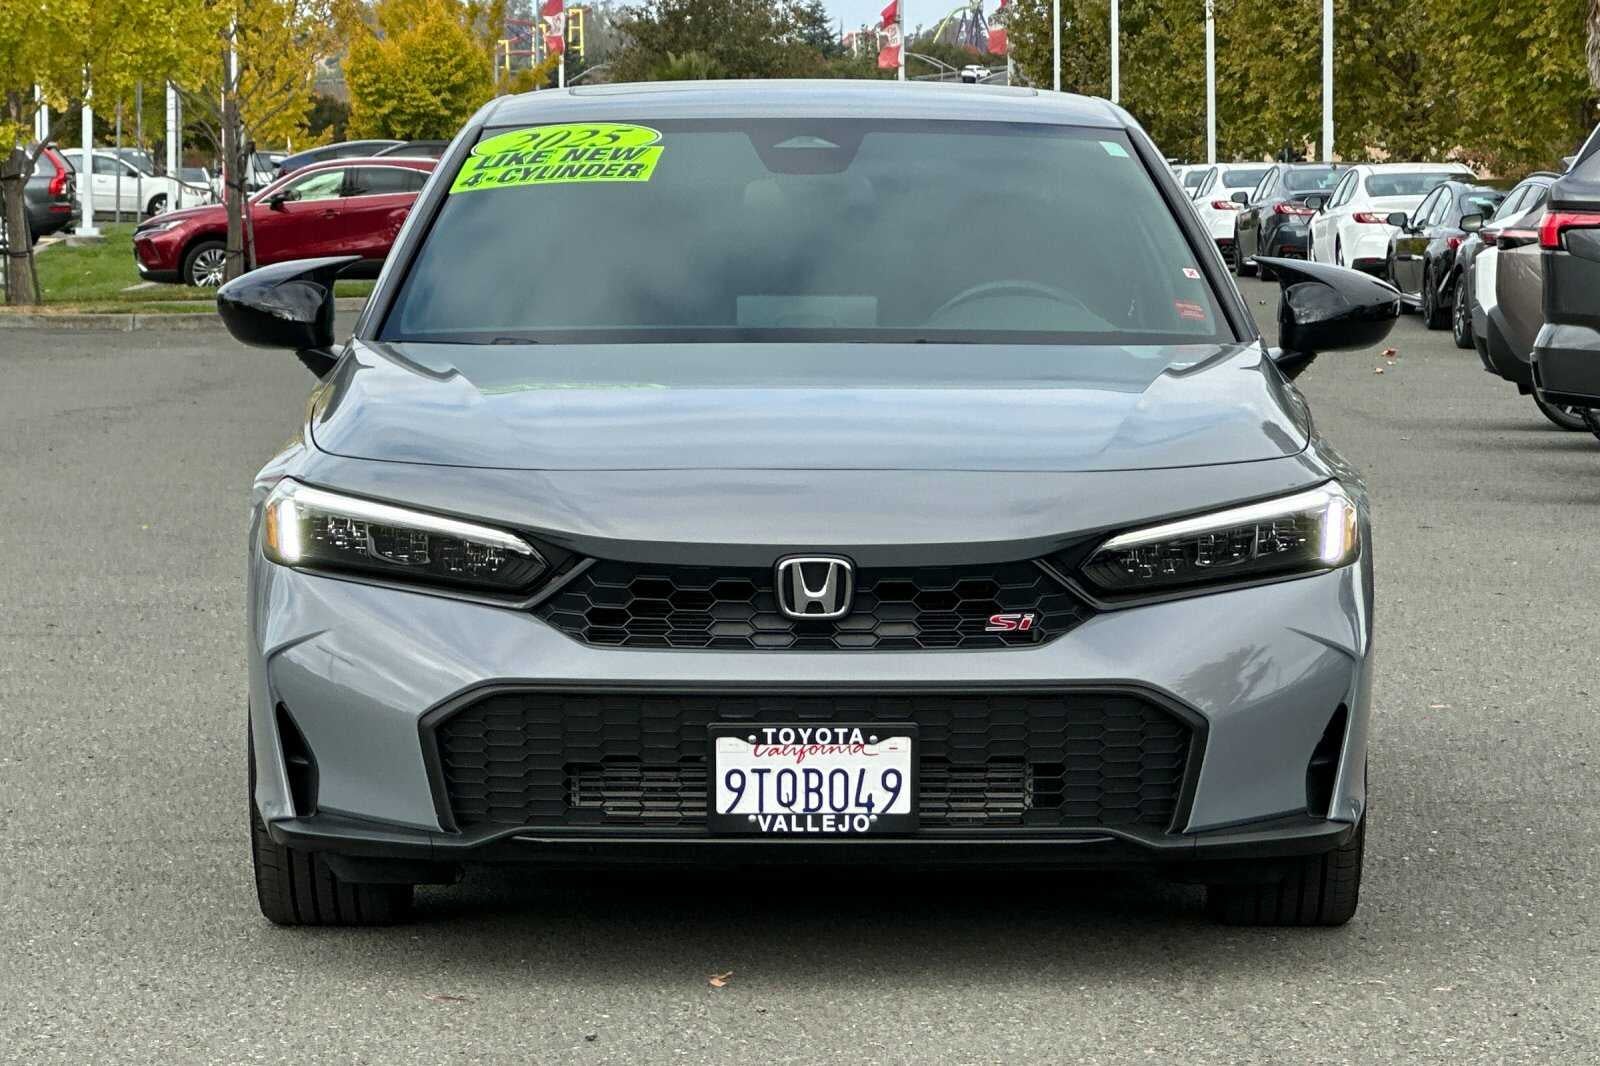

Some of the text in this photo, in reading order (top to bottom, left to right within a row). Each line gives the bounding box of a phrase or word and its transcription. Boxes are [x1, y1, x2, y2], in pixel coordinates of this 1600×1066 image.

[511, 129, 633, 150] 2025
[473, 147, 648, 170] LIKE NEW
[460, 163, 646, 187] 4-CYLINDER
[985, 613, 1034, 631] Si
[762, 727, 864, 745] TOYOTA
[724, 768, 903, 814] 9TQB049
[757, 814, 871, 832] VALLEJO
